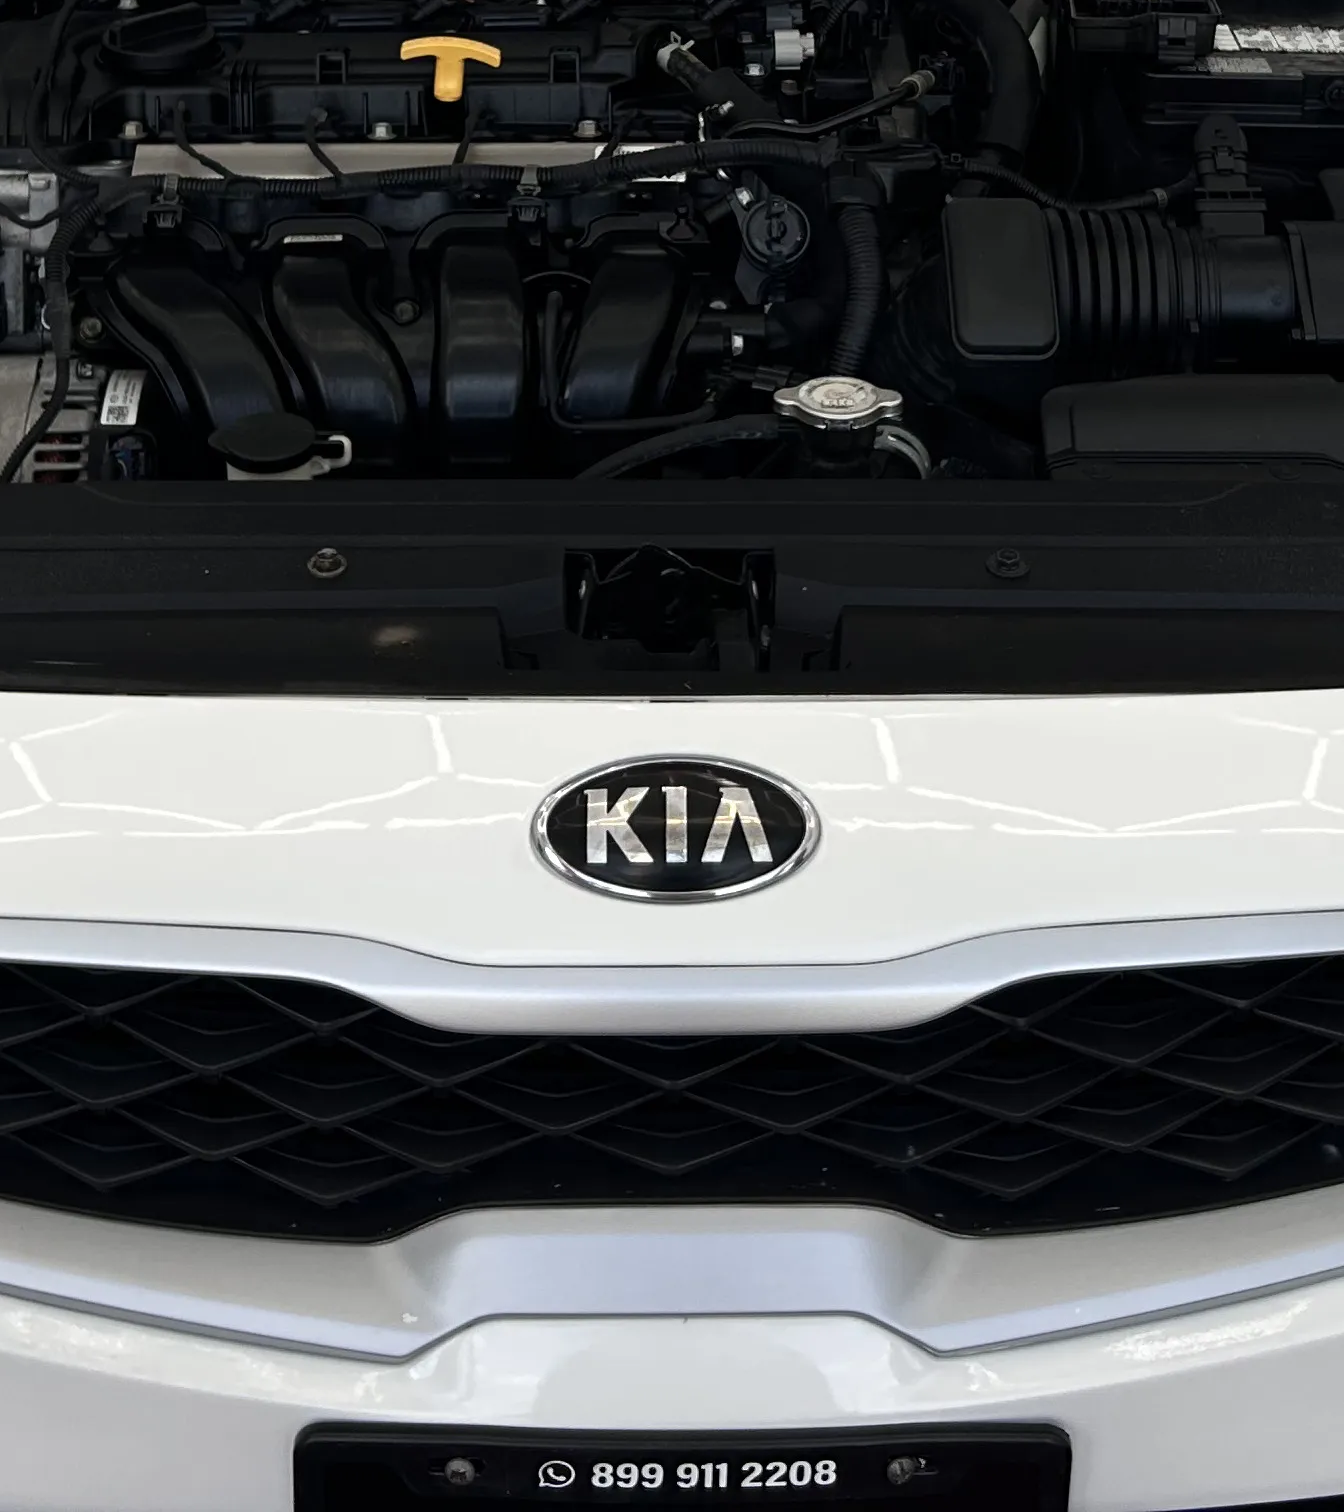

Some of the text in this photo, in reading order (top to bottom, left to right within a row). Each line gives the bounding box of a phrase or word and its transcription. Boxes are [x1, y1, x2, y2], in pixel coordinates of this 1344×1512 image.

[584, 786, 774, 863] KIA
[591, 1460, 837, 1488] 899 911 2208
